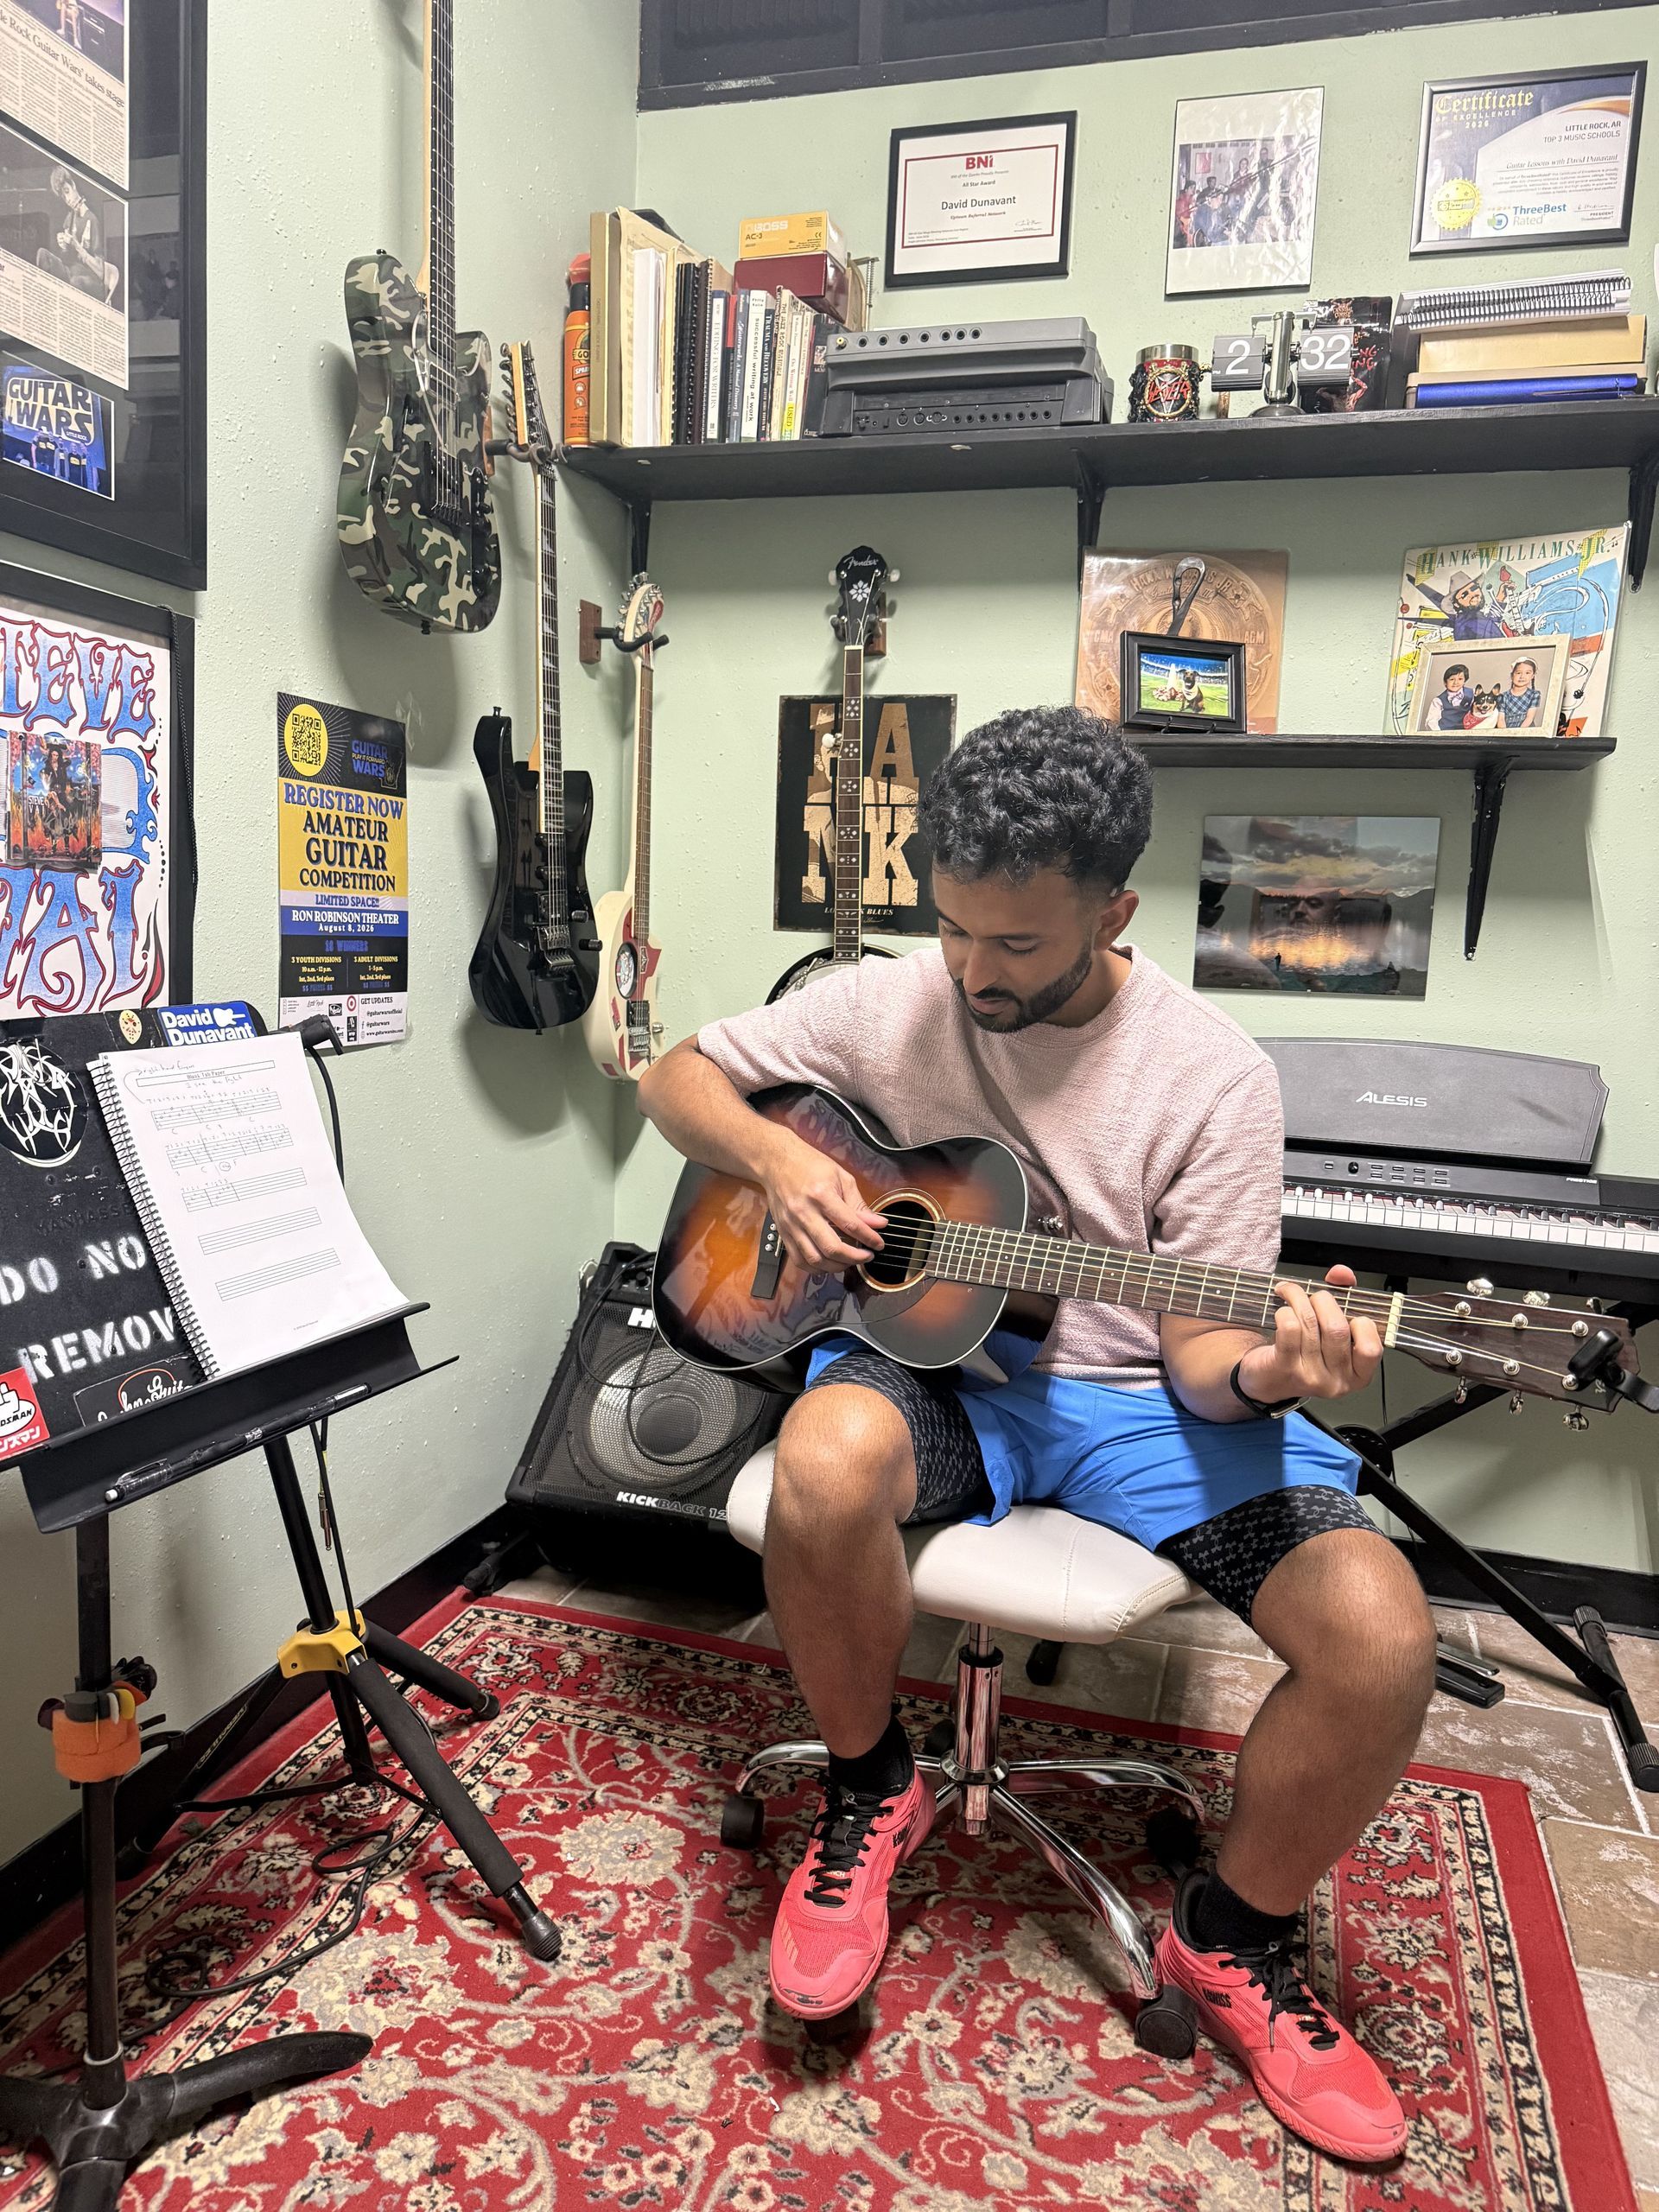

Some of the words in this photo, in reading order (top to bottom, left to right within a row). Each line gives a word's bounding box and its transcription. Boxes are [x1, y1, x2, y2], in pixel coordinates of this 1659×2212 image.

[10, 16, 31, 41] Rock
[33, 35, 60, 60] Guitar
[85, 73, 105, 93] takes
[1434, 90, 1535, 115] Certificate
[1453, 109, 1517, 122] EXCELLENCE
[1564, 133, 1586, 142] MUSIC
[1587, 130, 1621, 140] SCHOOLS
[1565, 124, 1588, 132] LITTLE
[1590, 122, 1610, 130] ROCK,
[941, 199, 968, 211] David
[970, 195, 1016, 207] Dunavant
[1513, 204, 1567, 216] ThreeBest
[1513, 216, 1543, 226] Rated
[1225, 340, 1250, 375] 2
[1300, 334, 1351, 371] 32
[762, 351, 771, 384] RECOVERY
[9, 379, 92, 412] GUITAR
[709, 375, 719, 410] WRITERS
[12, 400, 92, 441] WARS
[842, 554, 880, 570] Fender
[1420, 549, 1471, 575] HANK
[1580, 536, 1611, 562] JR.
[0, 620, 156, 743] TEVE
[352, 740, 388, 760] GUITAR
[352, 759, 385, 779] WARS
[28, 795, 45, 805] STEVE
[28, 804, 45, 814] VAI
[283, 782, 365, 814] REGISTER
[368, 796, 404, 820] NOW
[302, 810, 389, 842] AMATEUR
[306, 837, 388, 872] GUITAR
[299, 868, 396, 892] COMPETITION
[315, 894, 350, 907] LIMITED
[867, 907, 893, 916] BLUES
[292, 910, 313, 922] RON
[314, 911, 361, 924] ROBINSON
[362, 912, 399, 925] THEATER
[318, 924, 346, 933] August
[347, 925, 355, 933] 8,
[357, 924, 374, 932] 2026
[161, 1007, 213, 1029] David
[167, 1022, 255, 1046] Dunavant
[1356, 1090, 1427, 1108] ALESIS
[85, 1236, 147, 1280] NO
[17, 1306, 175, 1383] REMOV
[0, 1408, 33, 1427] DSMAN
[615, 1491, 707, 1516] KICKBACK
